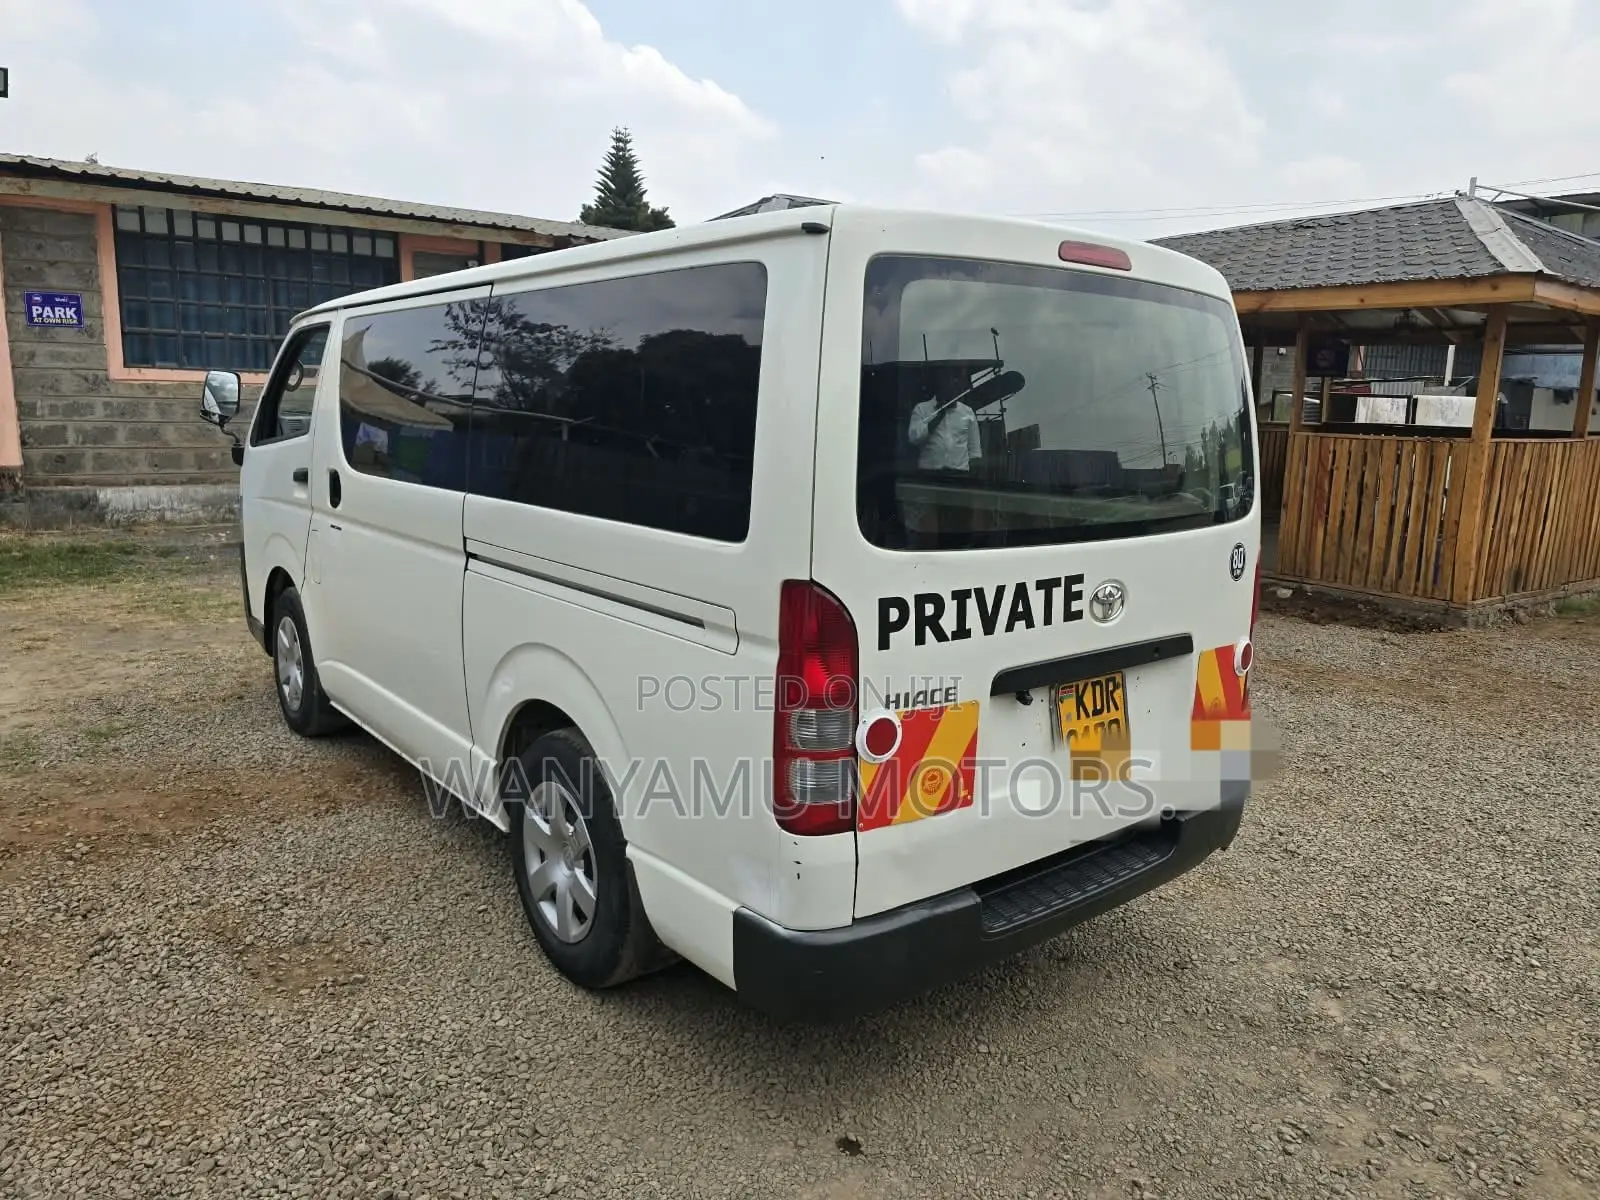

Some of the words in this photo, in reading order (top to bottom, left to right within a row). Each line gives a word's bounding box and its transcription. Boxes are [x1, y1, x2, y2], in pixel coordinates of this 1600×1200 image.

[31, 306, 77, 319] PARK
[1232, 547, 1244, 569] 80
[877, 573, 1085, 651] PRIVATE
[885, 686, 957, 710] HIACE
[1075, 676, 1119, 720] KDR
